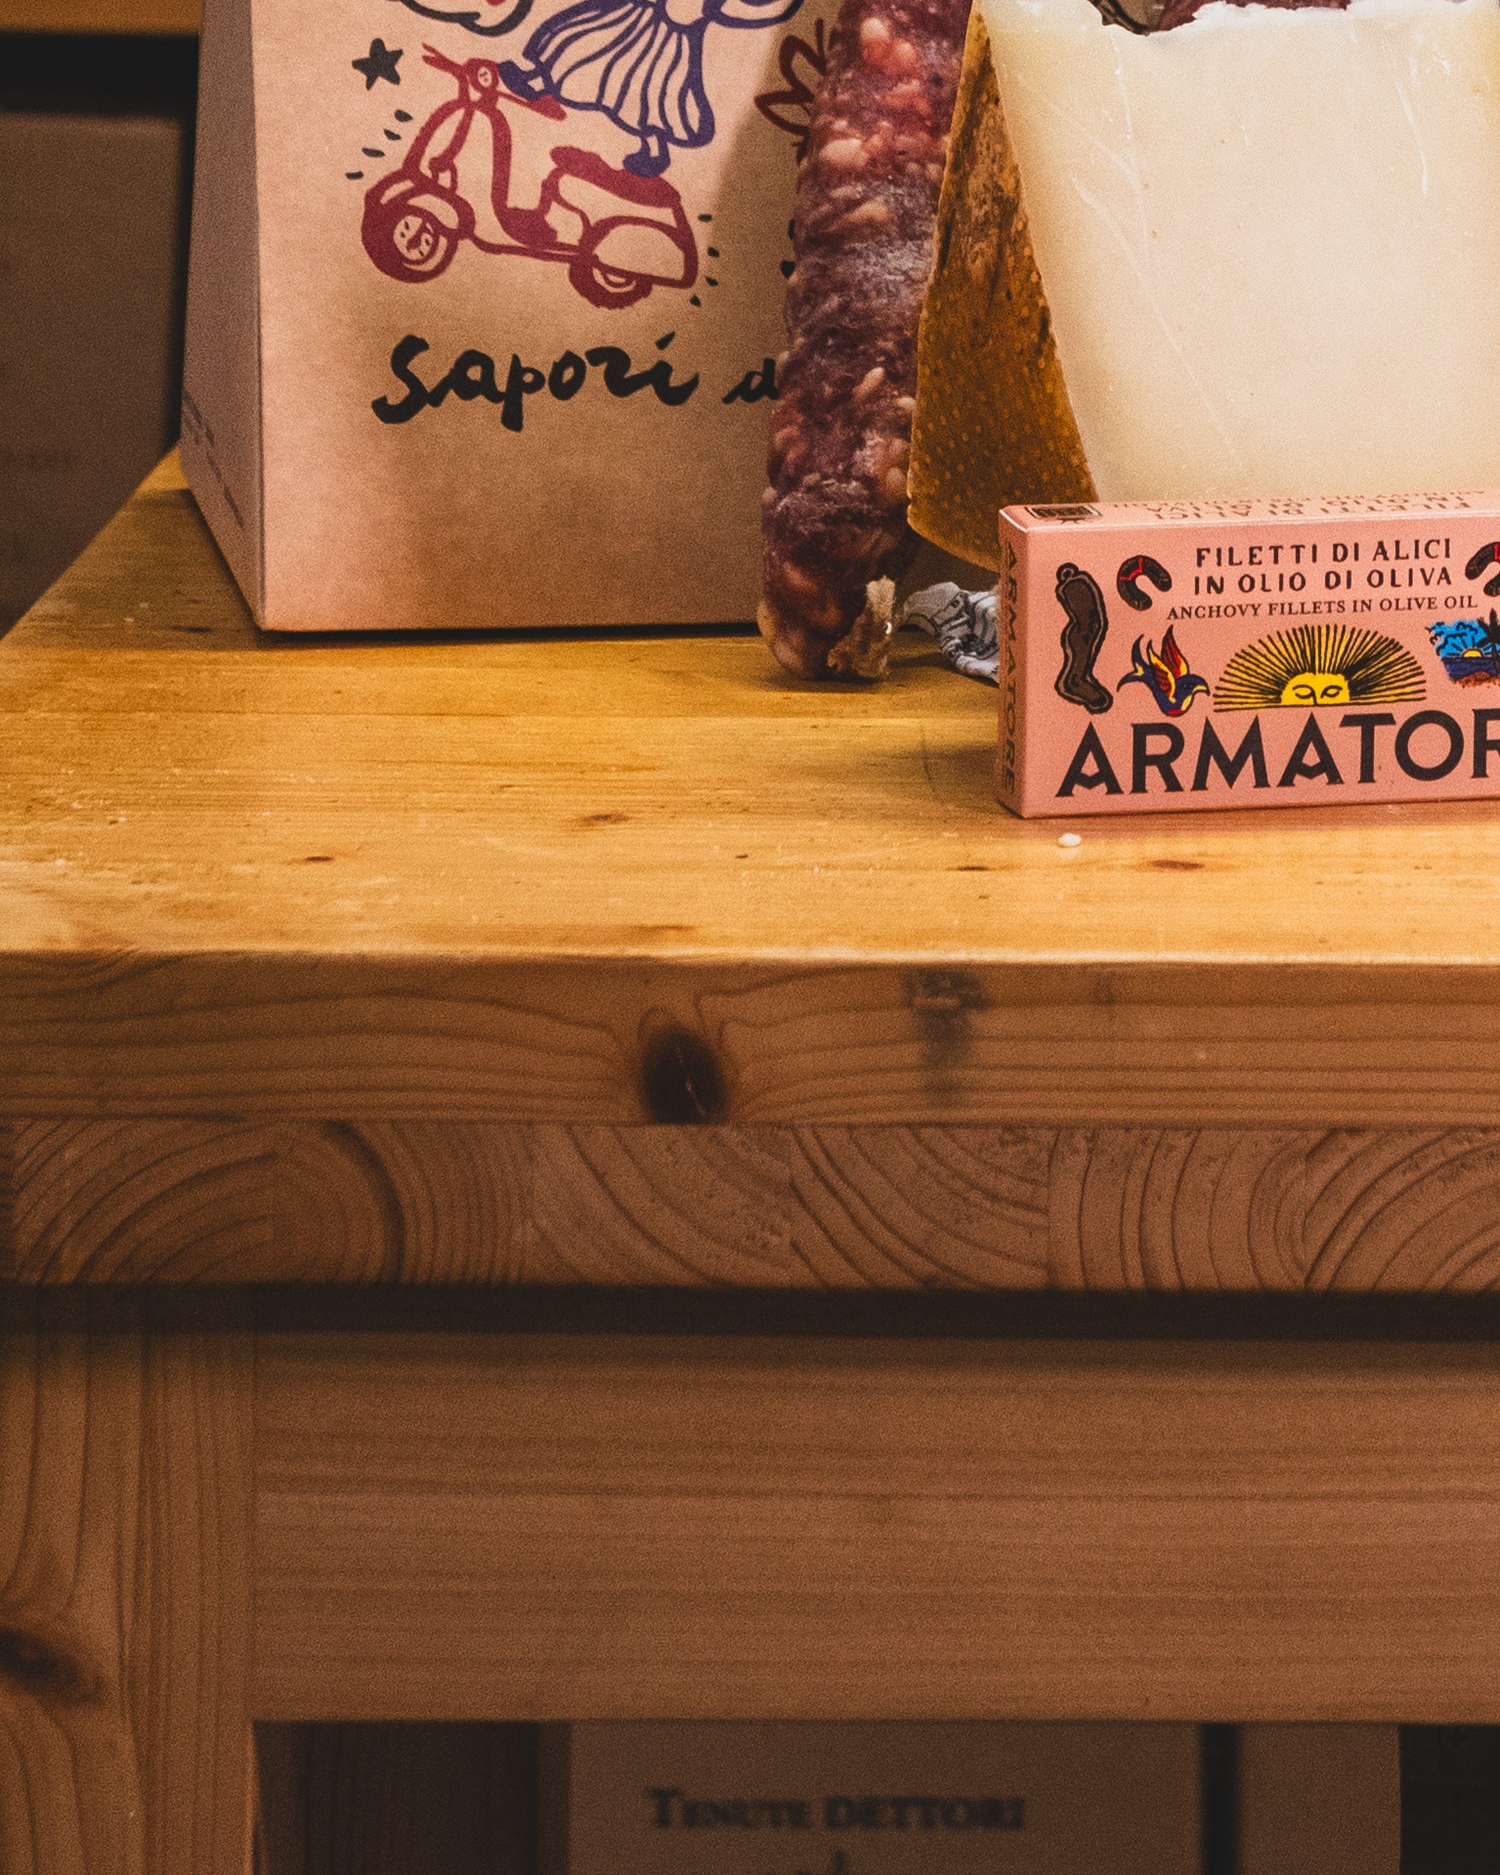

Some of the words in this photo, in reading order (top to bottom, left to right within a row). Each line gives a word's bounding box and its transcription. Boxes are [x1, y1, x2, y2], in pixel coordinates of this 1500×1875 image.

[371, 332, 699, 433] Sapori
[722, 358, 780, 404] d
[1196, 544, 1318, 567] FILETTI
[1332, 542, 1360, 562] DI
[1372, 537, 1451, 562] ALICI
[1194, 575, 1225, 595] IN
[1238, 572, 1306, 593] OLIO
[1324, 570, 1352, 590] DI
[1367, 566, 1452, 588] OLIVA
[1166, 603, 1262, 620] ANCHOVY
[1267, 600, 1346, 616] FILLETS
[1353, 599, 1372, 613] IN
[1379, 596, 1437, 611] OLIVE
[1444, 594, 1478, 609] OIL
